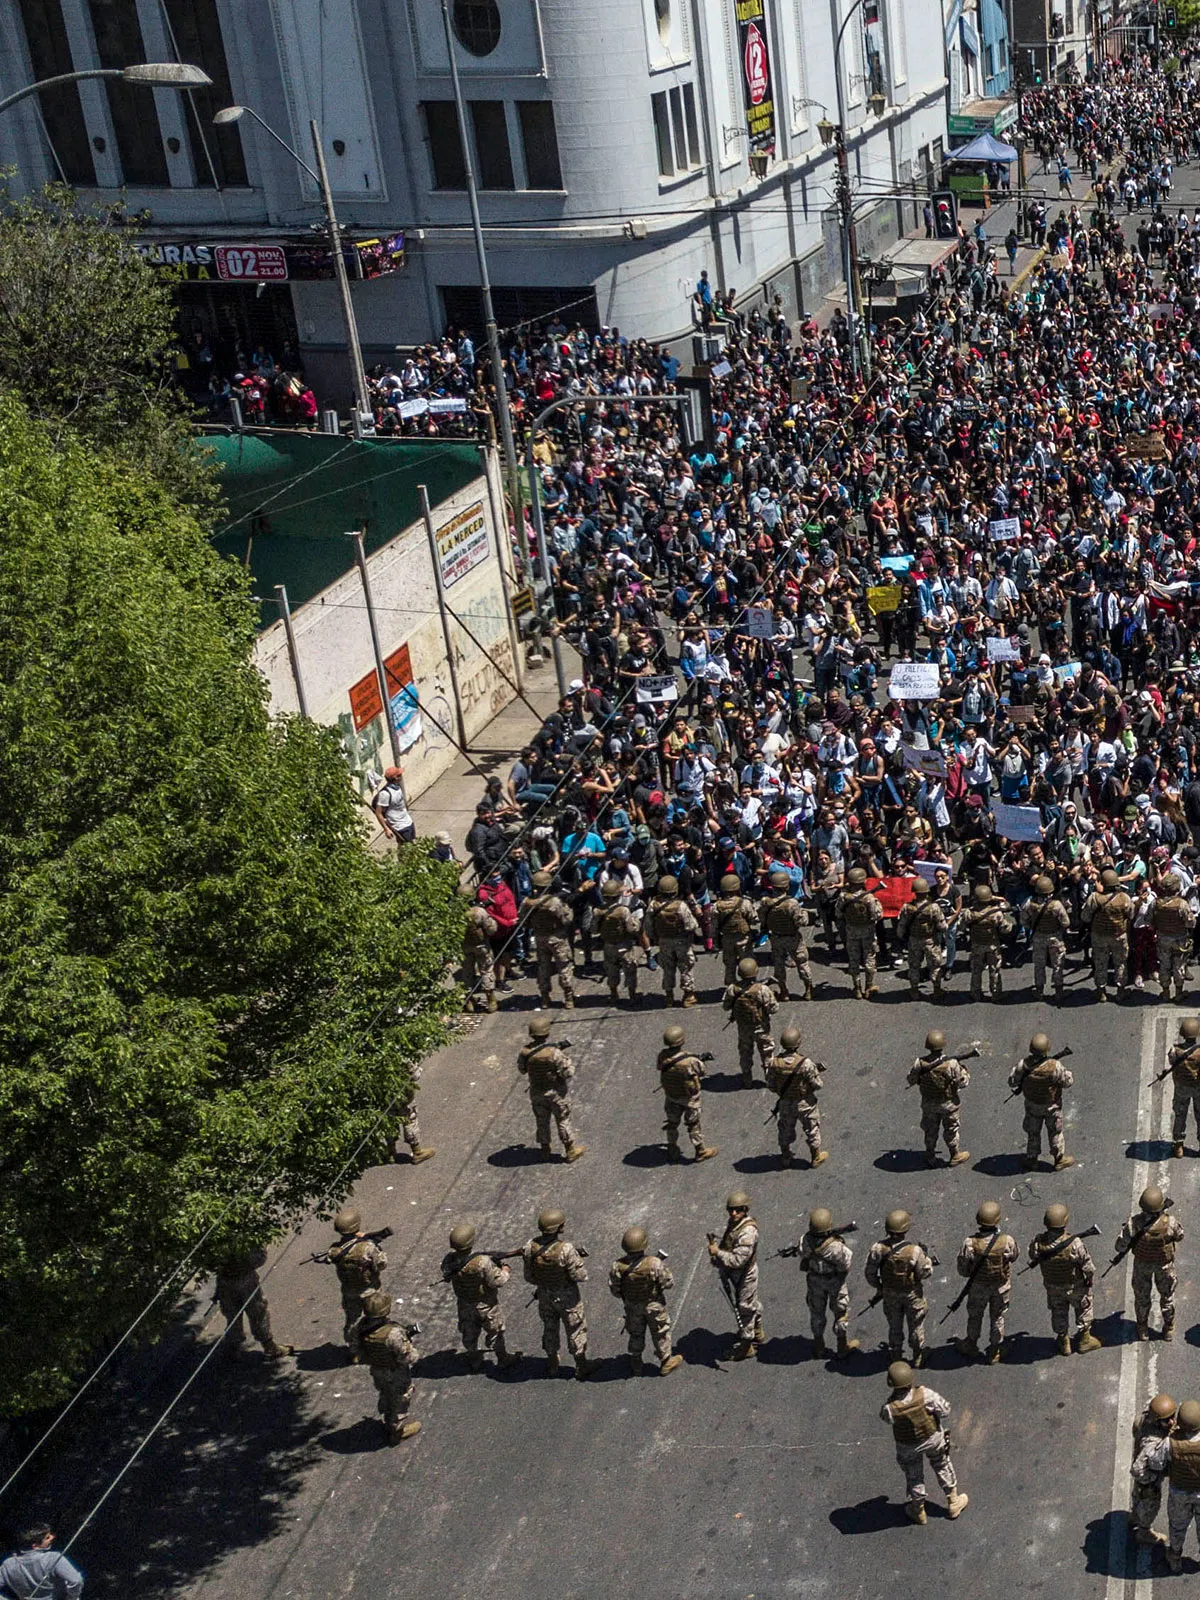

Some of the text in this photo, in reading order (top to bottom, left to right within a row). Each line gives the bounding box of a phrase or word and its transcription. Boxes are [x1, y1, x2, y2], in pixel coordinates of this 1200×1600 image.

[227, 250, 258, 276] 02
[258, 251, 282, 260] NOV.
[260, 268, 285, 276] 21.00
[441, 538, 454, 556] LA
[454, 516, 485, 544] MERCED
